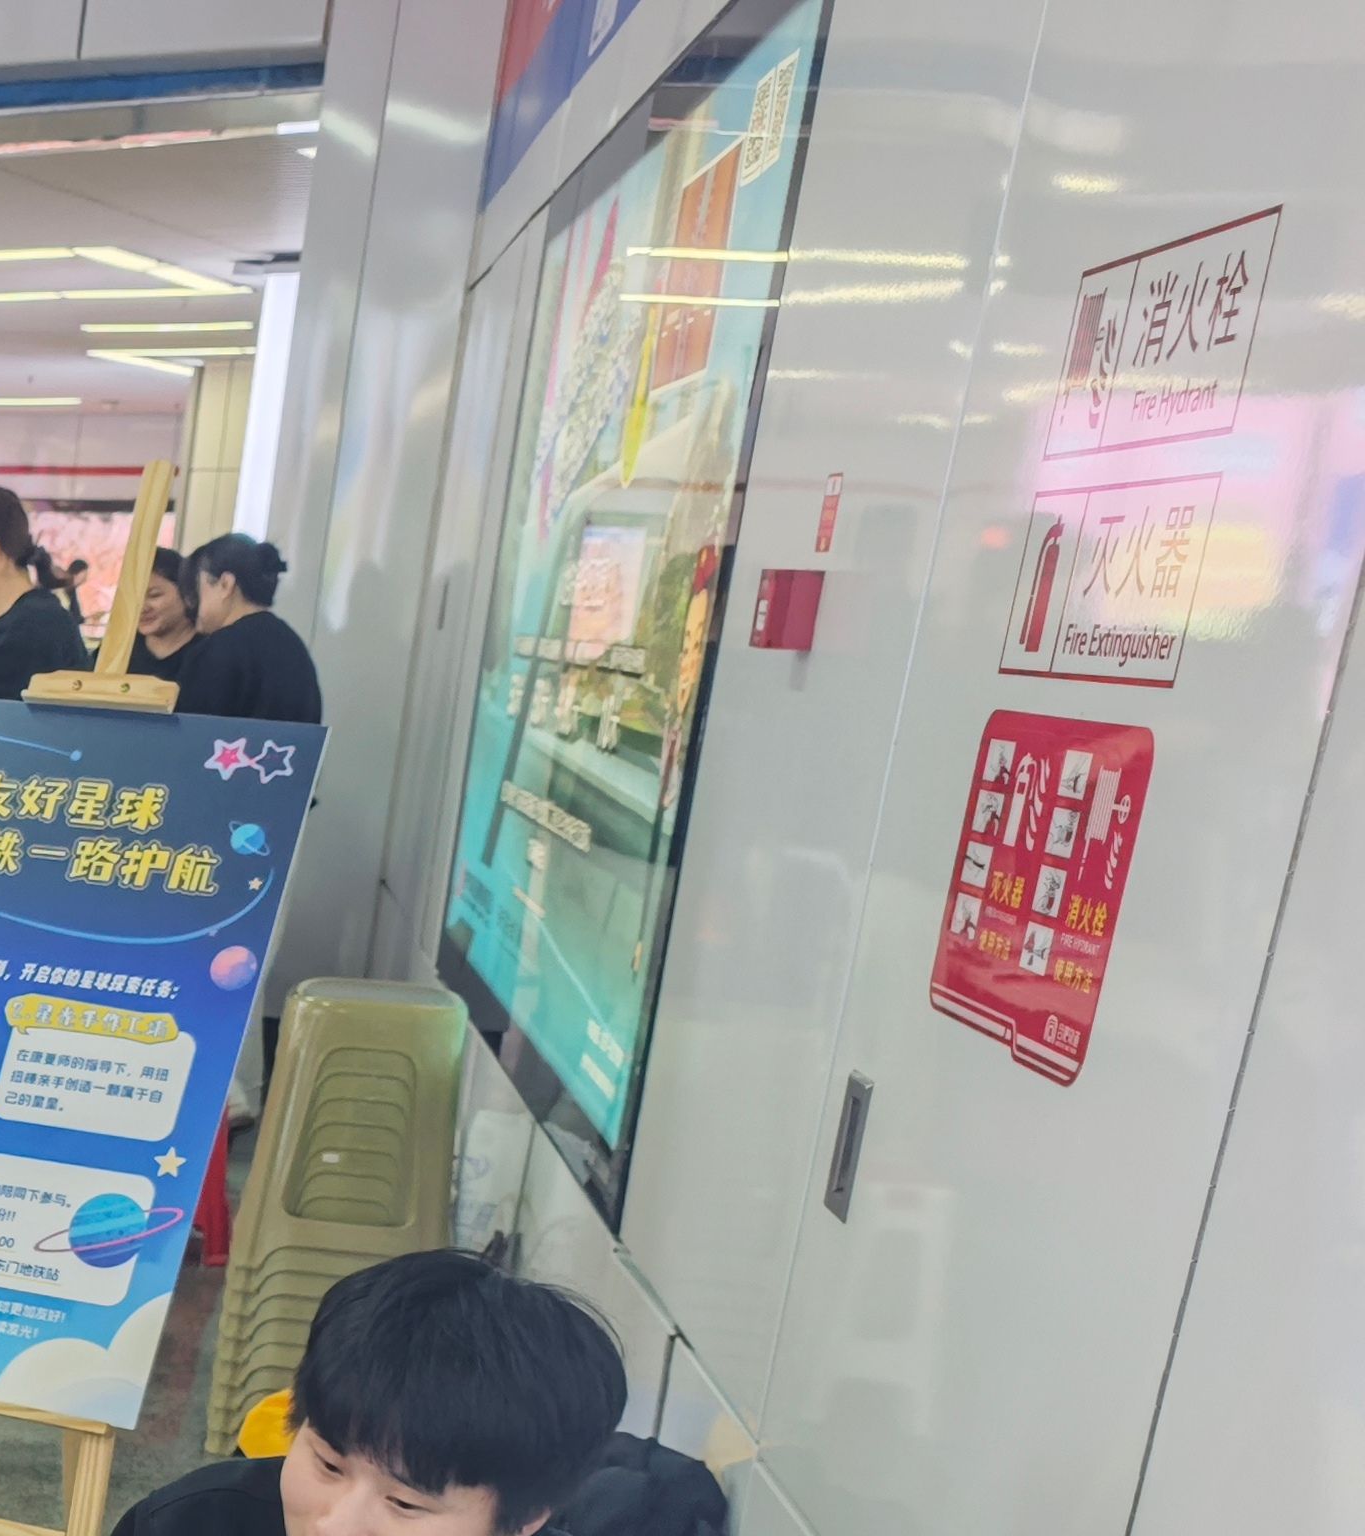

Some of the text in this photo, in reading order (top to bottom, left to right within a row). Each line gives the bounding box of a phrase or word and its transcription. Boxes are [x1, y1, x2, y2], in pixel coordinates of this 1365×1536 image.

[1132, 249, 1249, 367] 消火栓
[1131, 377, 1218, 426] Fire Hydrant
[1083, 504, 1195, 599] 灭火器
[1062, 622, 1177, 668] Fire Extinguisher
[989, 870, 1026, 909] 灭火器
[1064, 894, 1109, 937] 消火栓
